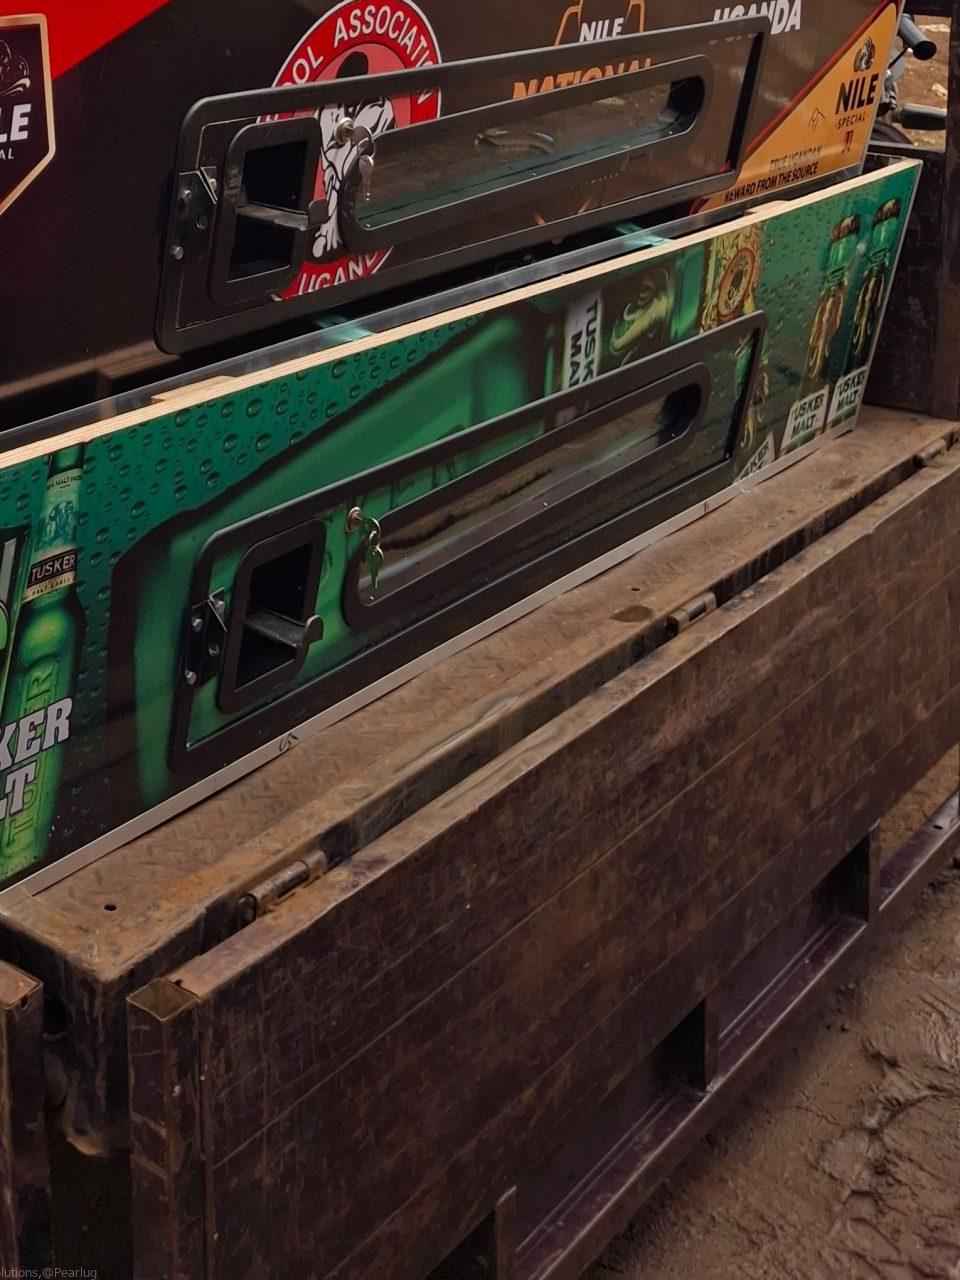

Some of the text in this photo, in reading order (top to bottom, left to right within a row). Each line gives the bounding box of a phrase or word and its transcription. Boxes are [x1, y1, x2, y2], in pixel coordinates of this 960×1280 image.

[579, 17, 624, 43] NILE
[835, 73, 879, 115] NILE
[836, 111, 866, 130] SPECIAL
[756, 173, 778, 192] FROM
[776, 171, 791, 186] THE
[791, 161, 818, 181] SOURCE
[792, 395, 824, 419] TUSKER
[793, 414, 817, 436] MALT
[31, 556, 76, 584] TUSKER
